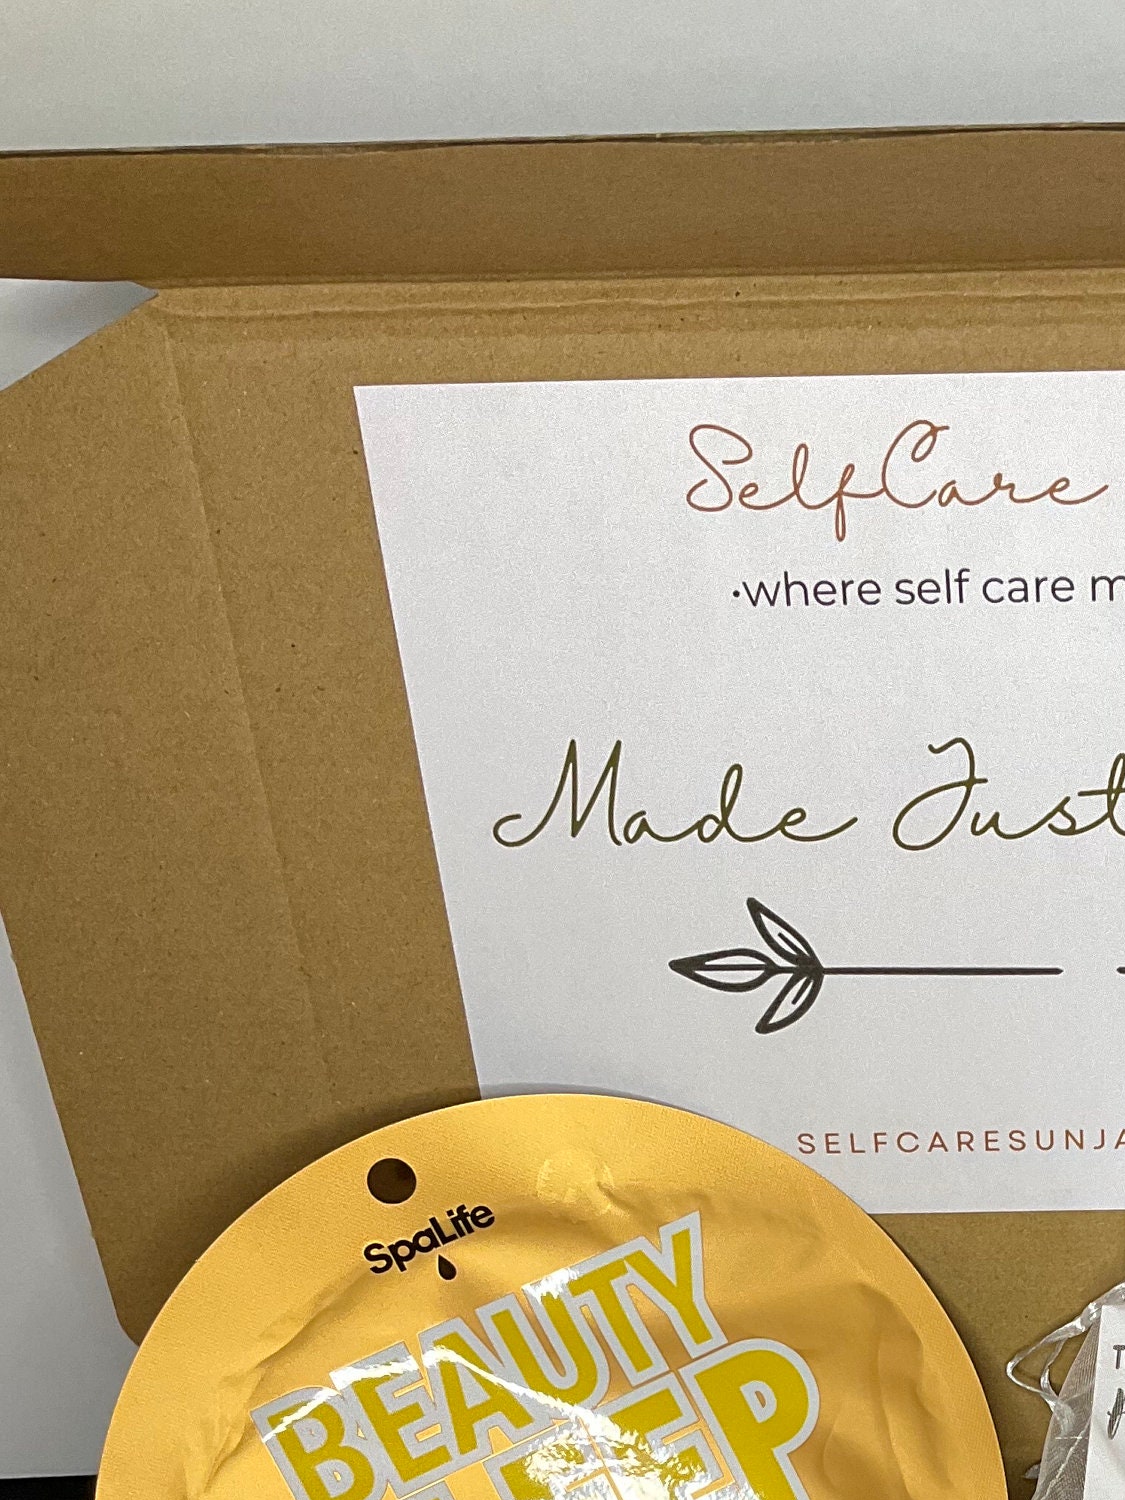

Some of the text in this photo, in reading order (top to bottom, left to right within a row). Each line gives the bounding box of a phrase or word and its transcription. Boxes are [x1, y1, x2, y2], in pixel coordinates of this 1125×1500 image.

[686, 420, 1108, 542] SelfCare
[894, 568, 969, 605] self
[982, 576, 1075, 603] care
[492, 739, 858, 848] Made
[363, 1204, 496, 1276] SpaLife
